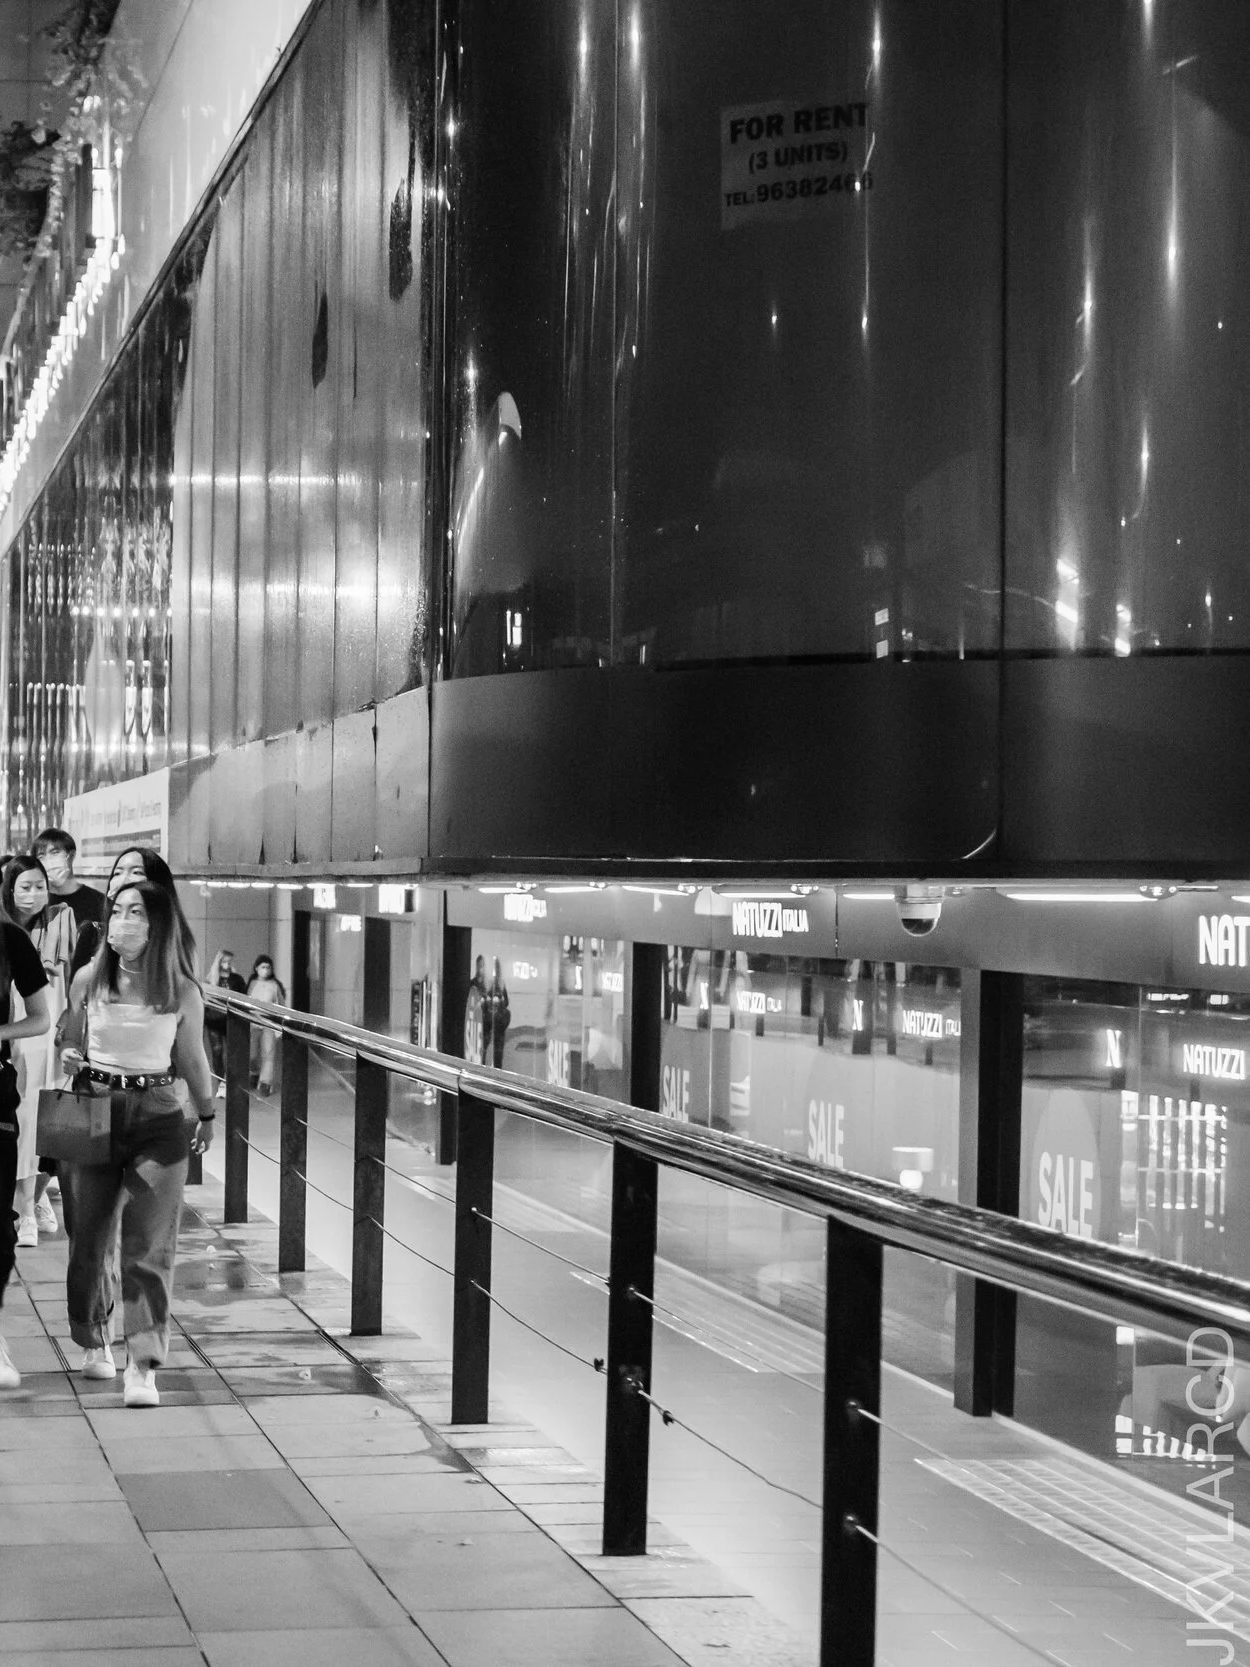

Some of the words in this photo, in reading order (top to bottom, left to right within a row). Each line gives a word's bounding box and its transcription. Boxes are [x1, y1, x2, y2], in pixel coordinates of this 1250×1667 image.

[729, 114, 784, 144] FOR
[793, 102, 868, 134] RENT
[748, 150, 768, 174] (3
[774, 141, 848, 168] UNITS)
[733, 902, 783, 937] NATUZZI
[783, 909, 809, 932] ITALIA
[902, 1010, 942, 1038] NATUZZI
[1105, 1029, 1122, 1068] N
[1182, 1043, 1246, 1080] NATUZZI
[663, 1065, 690, 1122] SALE
[808, 1099, 845, 1168] SALE
[1038, 1151, 1094, 1239] SALE
